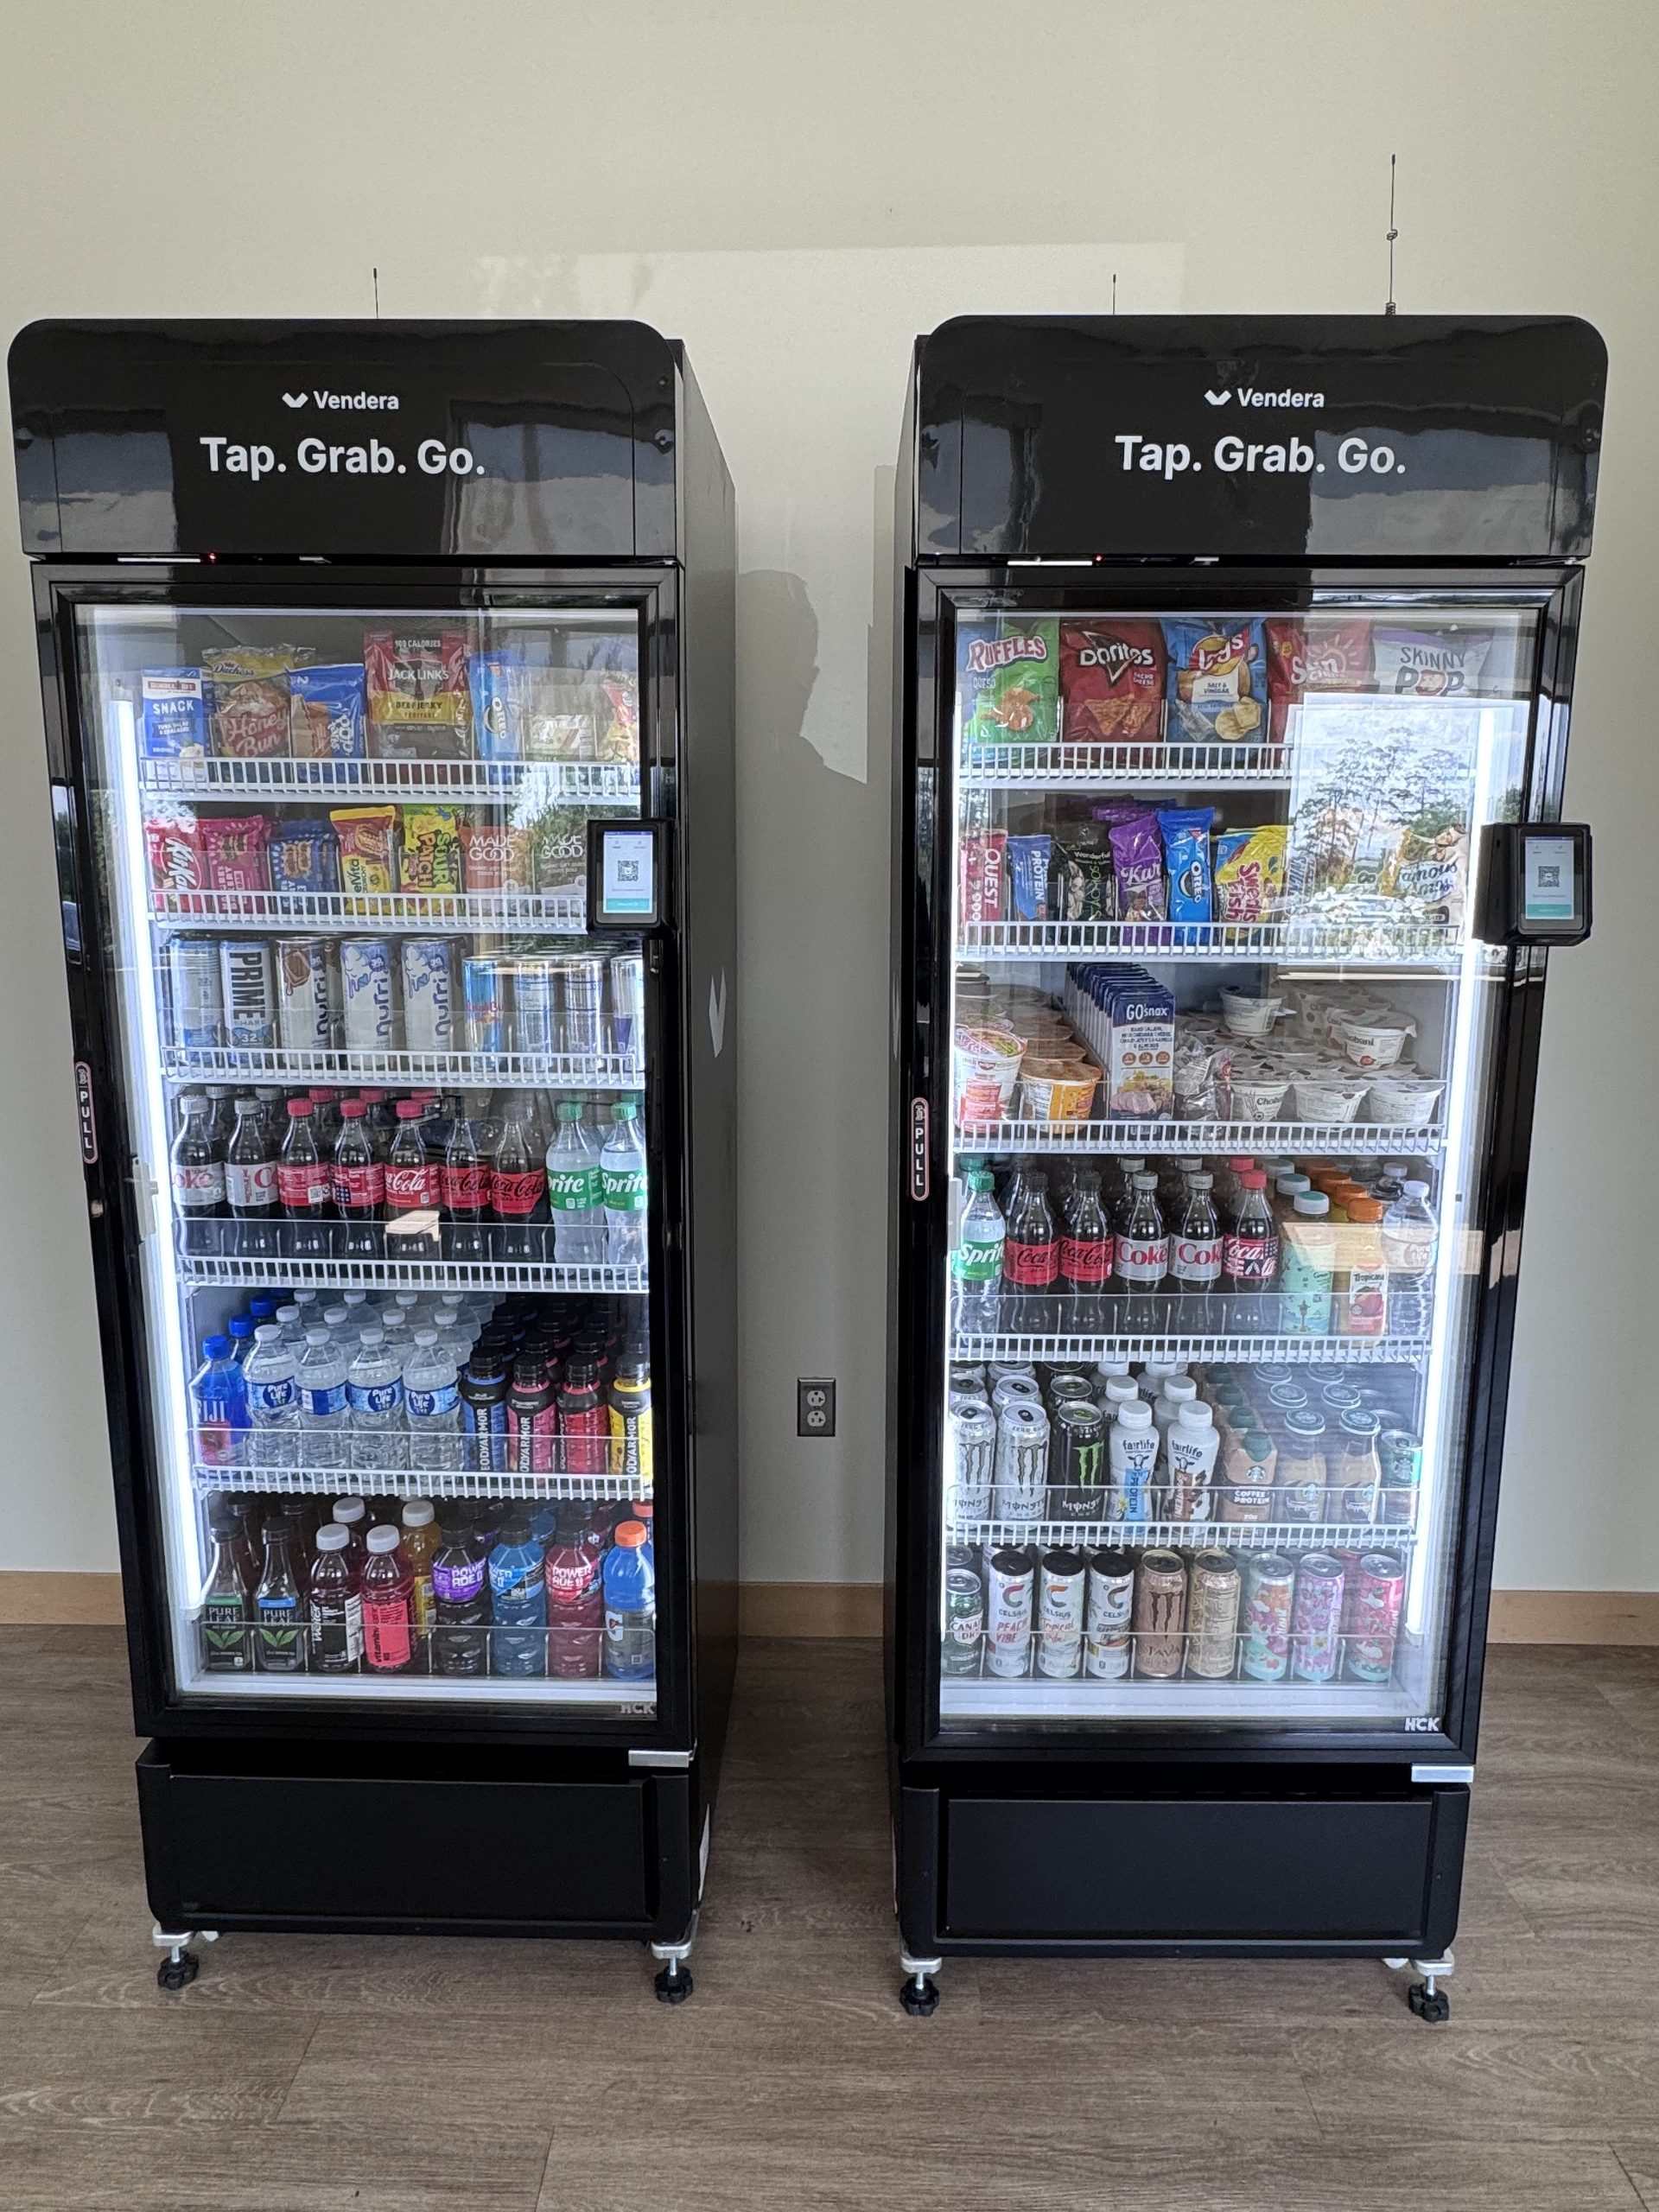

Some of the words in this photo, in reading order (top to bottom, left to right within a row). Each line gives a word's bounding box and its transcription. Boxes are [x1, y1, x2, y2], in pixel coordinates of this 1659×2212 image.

[314, 391, 400, 410] Vendera
[1236, 389, 1325, 408] Vendera
[200, 437, 287, 480] Tap.
[296, 438, 406, 474] Grab.
[416, 439, 485, 475] Go.
[1115, 435, 1202, 480] Tap.
[1214, 437, 1325, 474] Grab.
[1338, 437, 1406, 474] Go.
[966, 635, 1048, 672] RUFFLES
[1080, 643, 1154, 667] Doritos
[1400, 646, 1466, 670] SKINNY
[213, 664, 254, 677] Duchess
[387, 668, 416, 681] JACK
[152, 700, 194, 715] SNACK
[492, 696, 507, 740] OREO
[223, 708, 288, 741] Honey
[236, 734, 283, 758] Bun
[469, 834, 516, 848] MADE
[541, 844, 584, 860] GOOD
[416, 831, 435, 888] PATCH
[435, 830, 451, 887] SOUR
[469, 846, 515, 862] GOOD
[349, 858, 362, 893] elVita
[983, 848, 1001, 909] QUEST
[1031, 850, 1045, 900] PROTEIN
[1190, 861, 1203, 904] OREO
[229, 952, 265, 1020] PRIME
[373, 977, 392, 1037] nurri
[433, 977, 451, 1037] nurri
[241, 1033, 257, 1043] 32
[79, 1090, 92, 1149] PULL
[914, 1128, 924, 1186] PULL
[174, 1168, 214, 1190] oke
[548, 1174, 586, 1193] prite
[960, 1243, 1006, 1266] Sprit
[1117, 1241, 1167, 1266] Coke
[1178, 1243, 1224, 1266] Cok
[372, 1388, 392, 1398] Pure
[375, 1395, 392, 1405] Life
[410, 1391, 430, 1401] Pure
[412, 1400, 429, 1409] Life
[519, 1416, 531, 1474] ODYARMOR
[626, 1416, 637, 1474] ODYARMOR
[1122, 1439, 1155, 1451] fairlife
[1172, 1440, 1204, 1459] fairlife
[1001, 1497, 1044, 1511] MONST
[1062, 1496, 1101, 1512] MONST
[451, 1559, 486, 1578] POWE
[552, 1563, 592, 1578] POWER
[208, 1606, 239, 1616] PURE
[264, 1609, 293, 1618] PURE
[1042, 1605, 1072, 1618] CELSIUS
[997, 1617, 1028, 1631] PEACH
